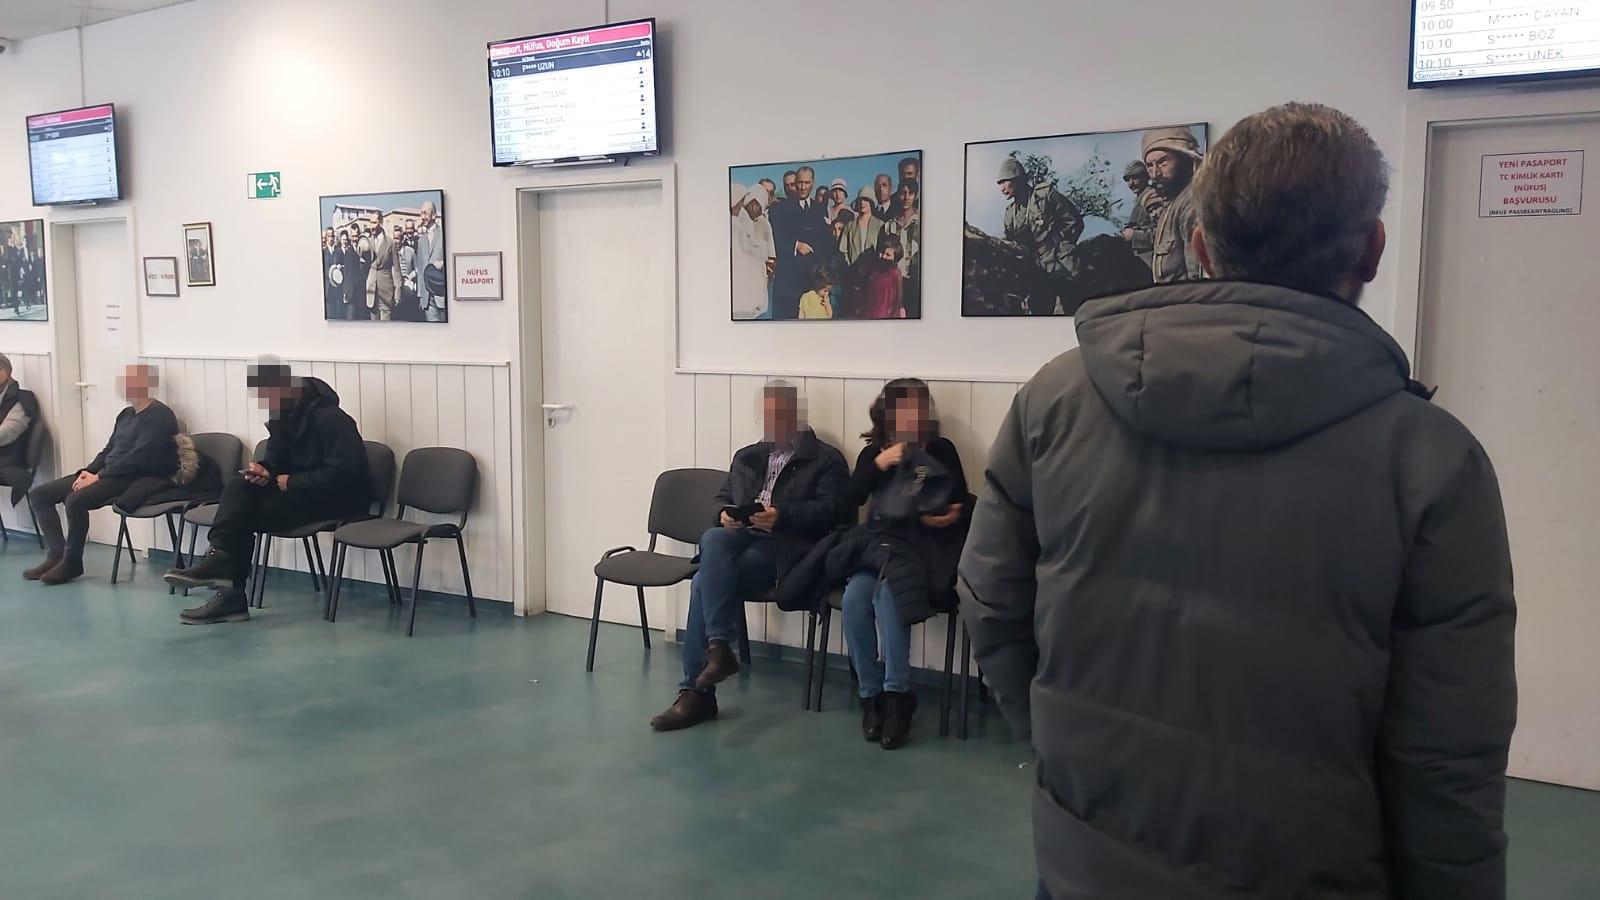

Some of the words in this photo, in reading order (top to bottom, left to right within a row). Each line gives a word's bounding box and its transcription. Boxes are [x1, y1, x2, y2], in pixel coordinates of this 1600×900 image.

[1421, 18, 1454, 32] 10:00
[523, 41, 545, 52] Nüfus,
[546, 37, 571, 50] Doğum
[572, 35, 590, 46] Kayıt
[1420, 38, 1453, 51] 10:10
[1529, 28, 1556, 42] BOZ
[492, 67, 511, 78] 10:10
[537, 61, 555, 71] UZUN
[641, 48, 651, 59] 14
[1520, 158, 1568, 167] PASAPORT
[1511, 172, 1538, 180] KİMLİK
[1514, 183, 1547, 192] (NÜFUS)
[1503, 196, 1557, 205] BAŞVURUSU
[467, 268, 488, 276] NÜFUS
